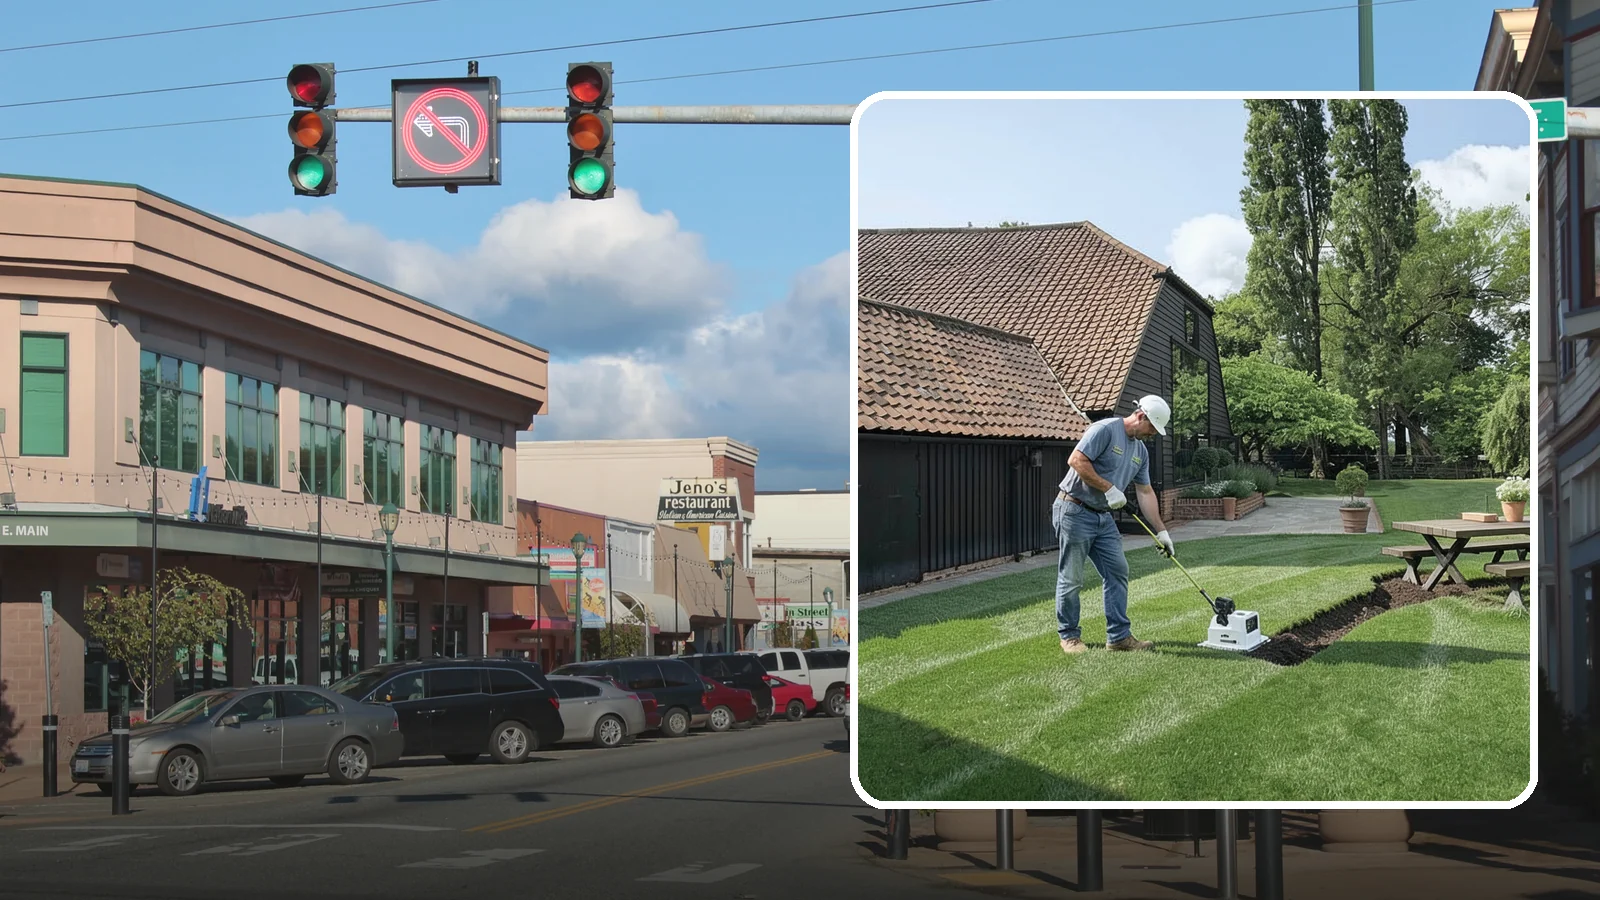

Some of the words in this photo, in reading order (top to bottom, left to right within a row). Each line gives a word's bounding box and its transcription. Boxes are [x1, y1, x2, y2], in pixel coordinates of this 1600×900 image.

[670, 480, 727, 494] Jeno's
[665, 497, 730, 509] restaurant
[686, 510, 714, 519] American
[715, 510, 737, 519] Cuisine
[2, 526, 13, 536] E.
[16, 526, 48, 536] MAIN
[786, 608, 794, 616] in
[798, 608, 828, 616] Street
